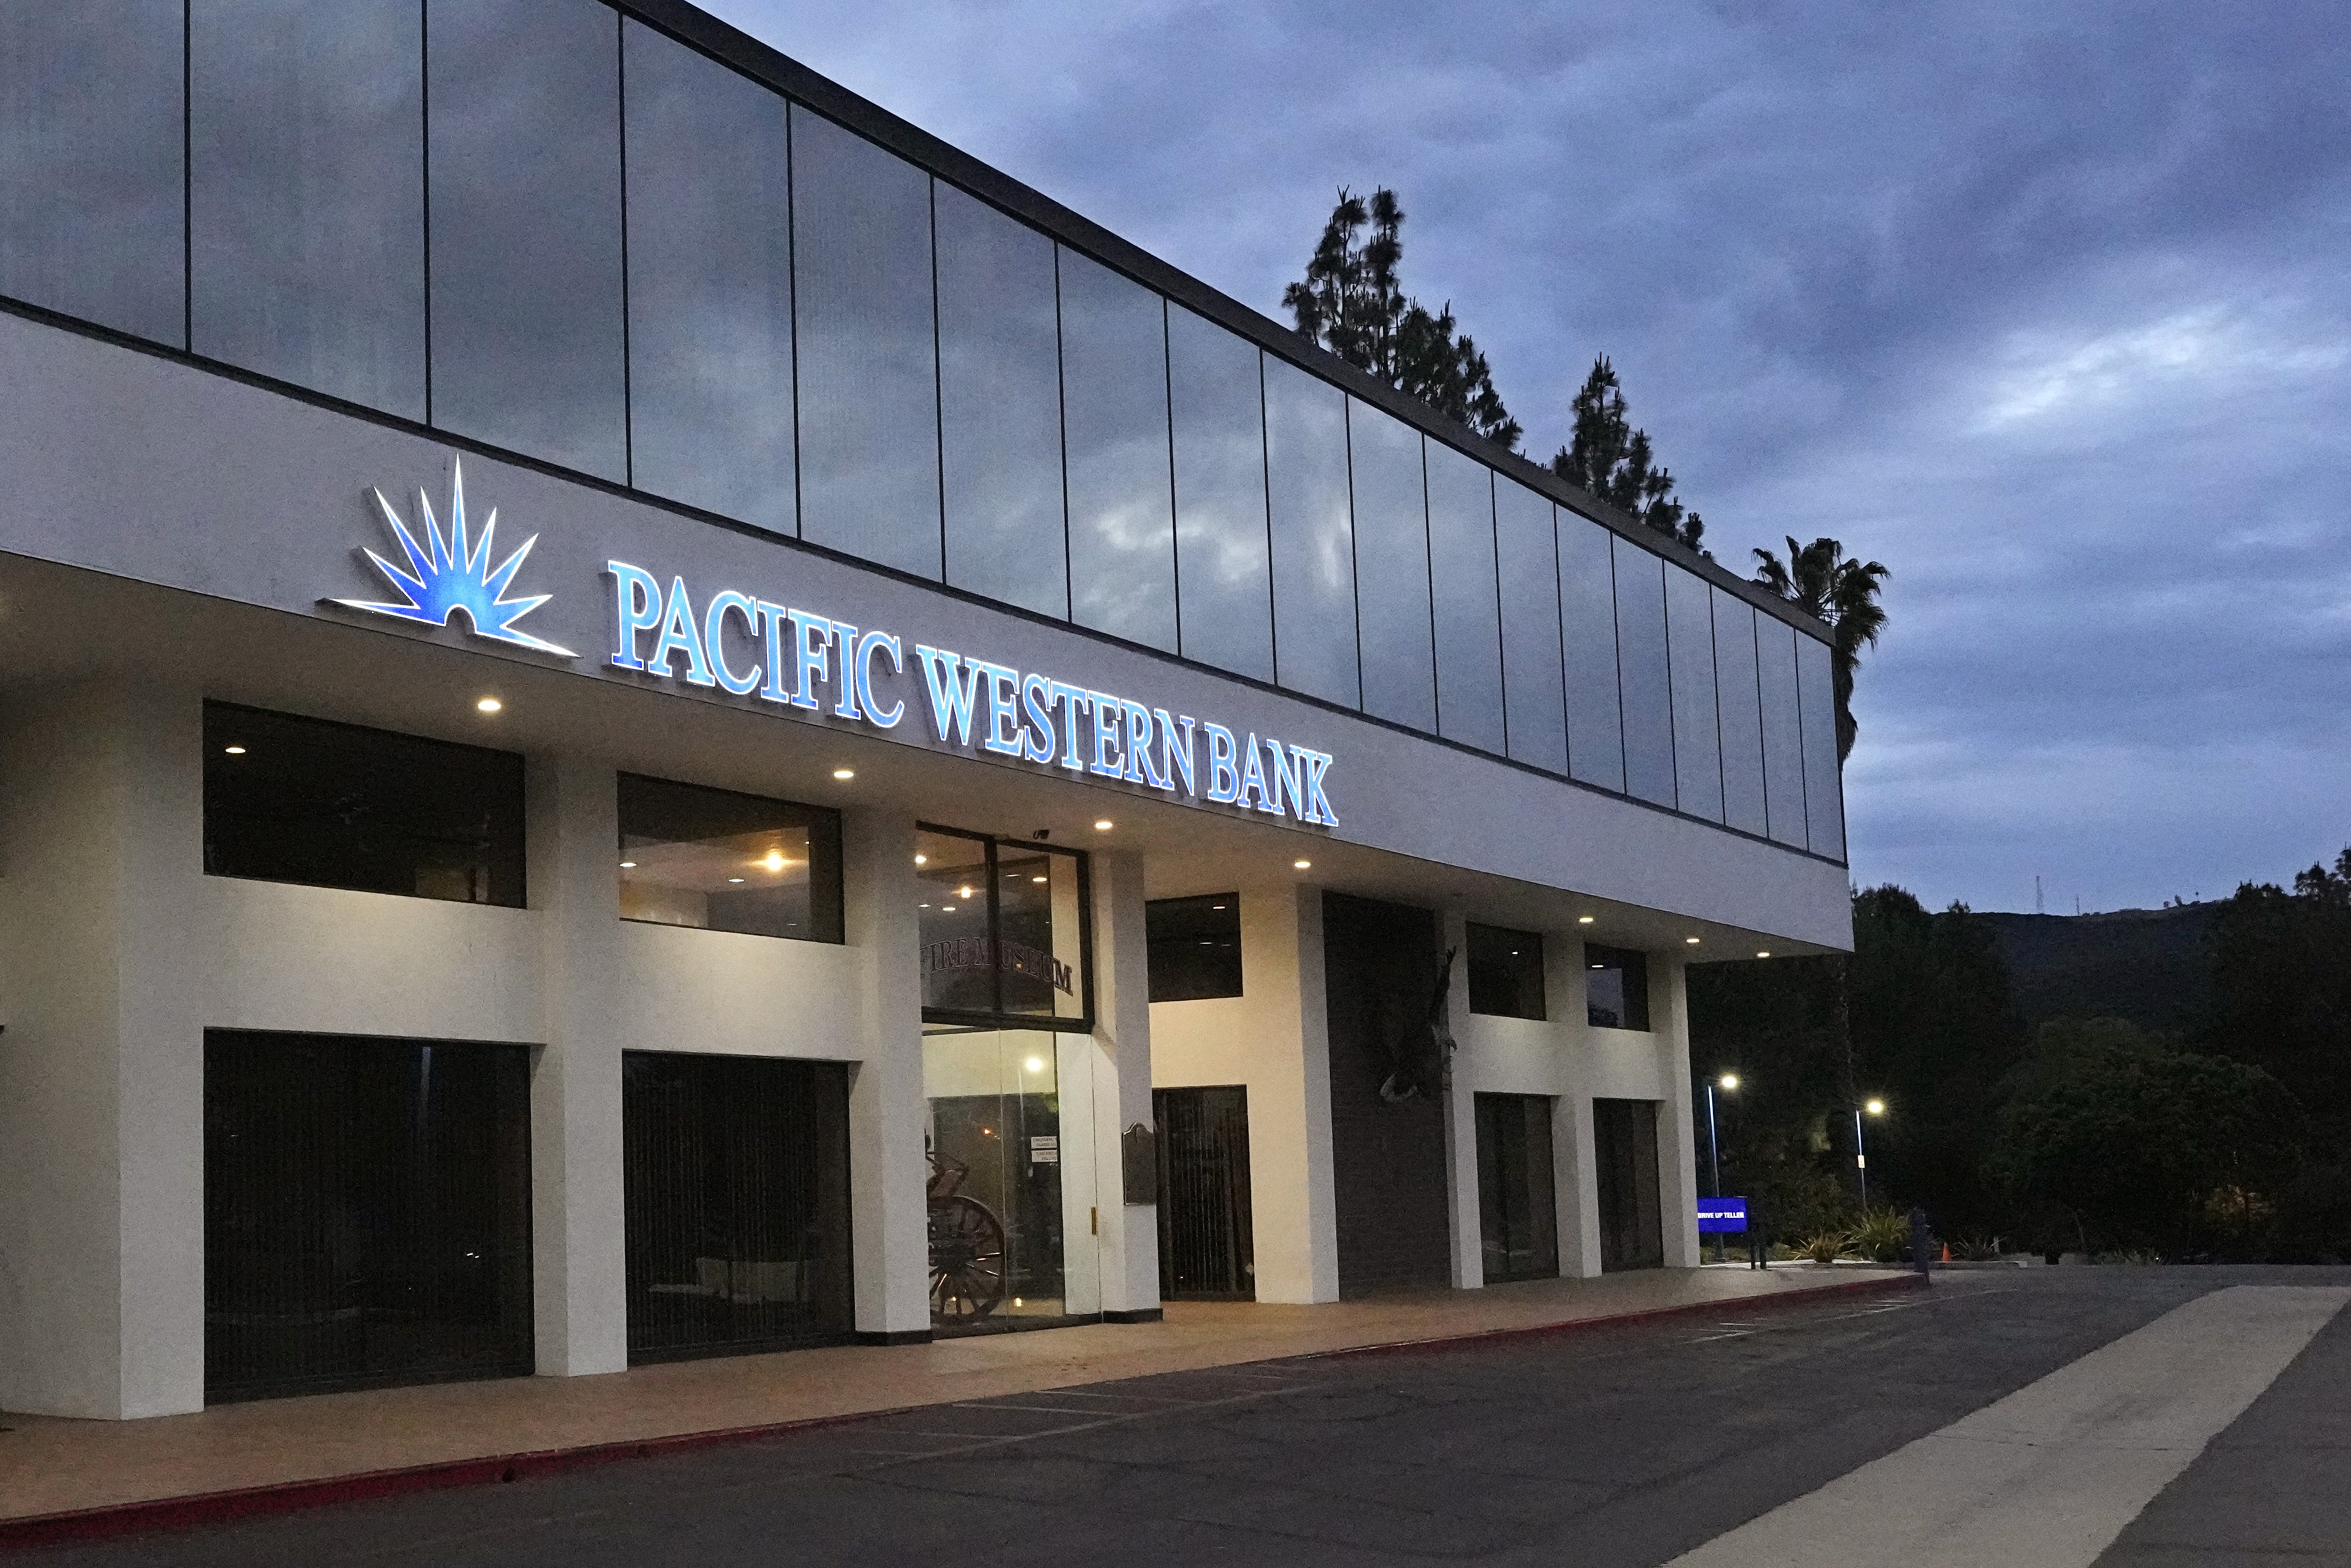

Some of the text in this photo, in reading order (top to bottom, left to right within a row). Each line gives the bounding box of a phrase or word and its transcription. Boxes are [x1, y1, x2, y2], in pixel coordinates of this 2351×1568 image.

[608, 559, 1339, 827] PACIFIC WESTERN BANK
